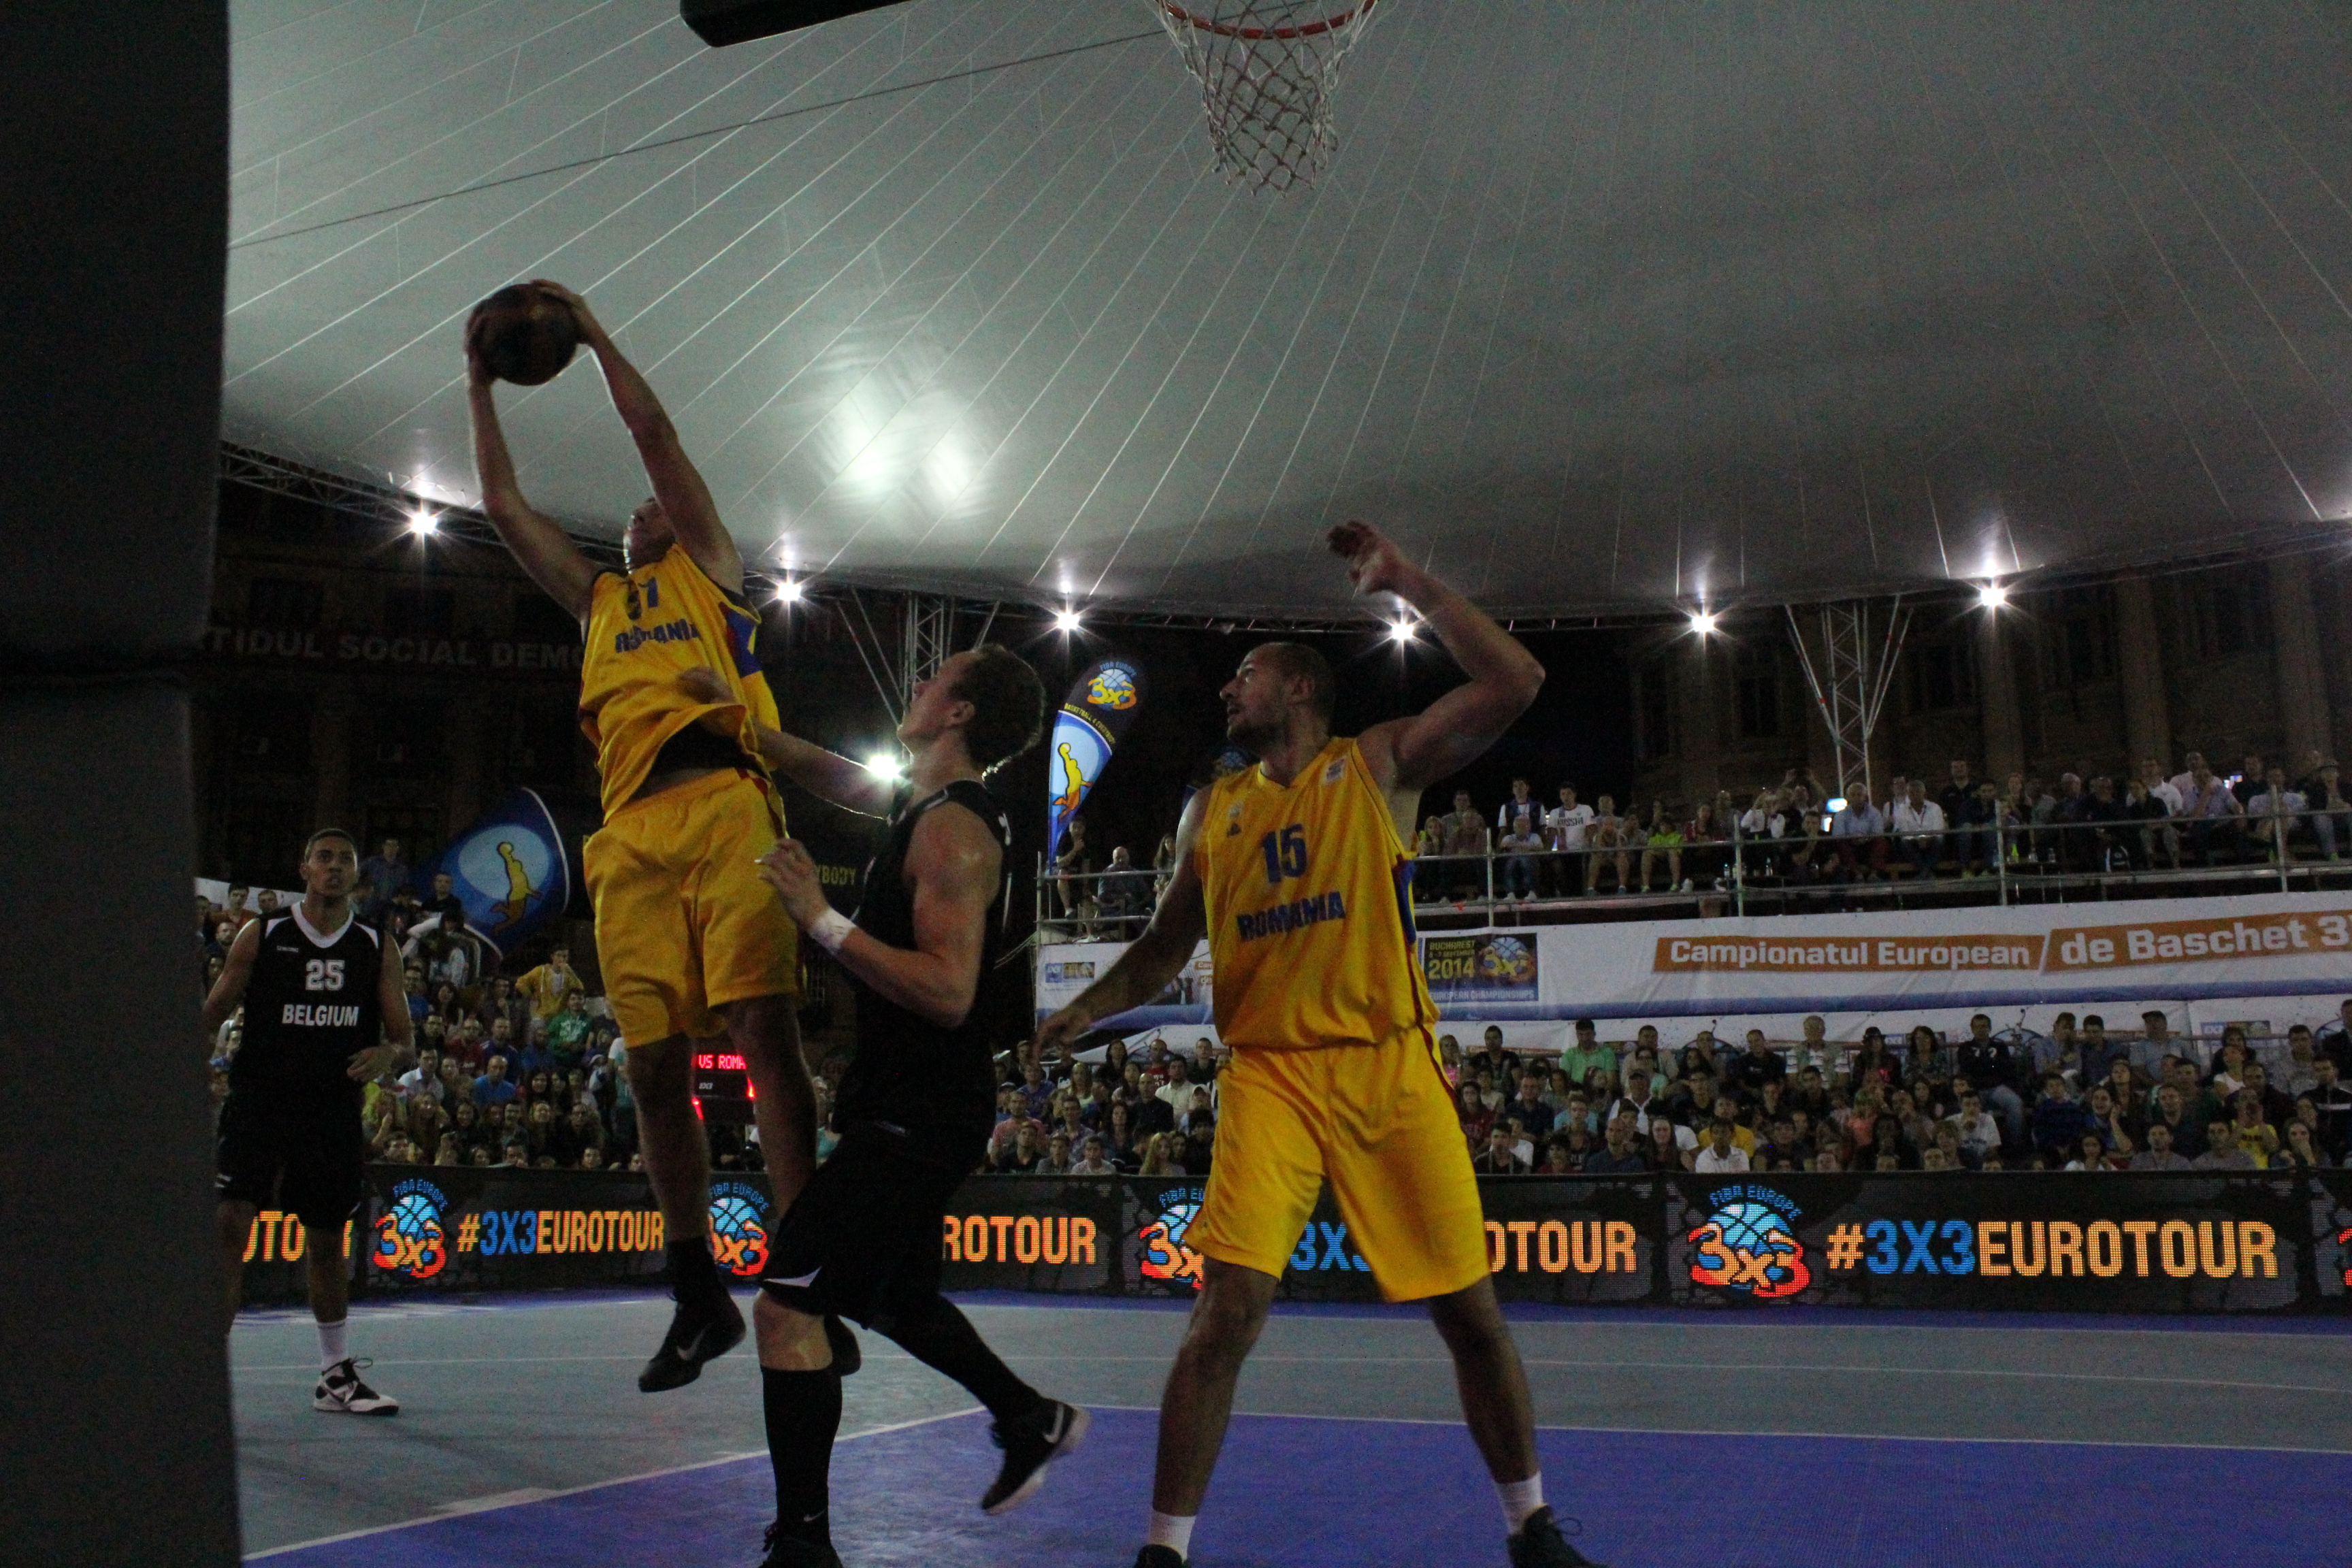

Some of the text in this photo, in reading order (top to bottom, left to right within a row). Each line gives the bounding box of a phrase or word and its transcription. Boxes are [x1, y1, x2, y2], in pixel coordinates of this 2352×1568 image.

[338, 634, 478, 666] SOCIAL
[1262, 823, 1307, 883] 15
[1237, 891, 1346, 943] ROMANIA
[1669, 914, 2352, 970] Campionatul European de Baschet 3
[306, 958, 345, 991] 25
[1428, 957, 1475, 980] 2014
[281, 1003, 360, 1026] BELGIUM
[698, 1054, 713, 1069] VS
[457, 1209, 665, 1257] #3X3EUROTOUR
[1825, 1218, 2279, 1279] #3X3EUROTOUR
